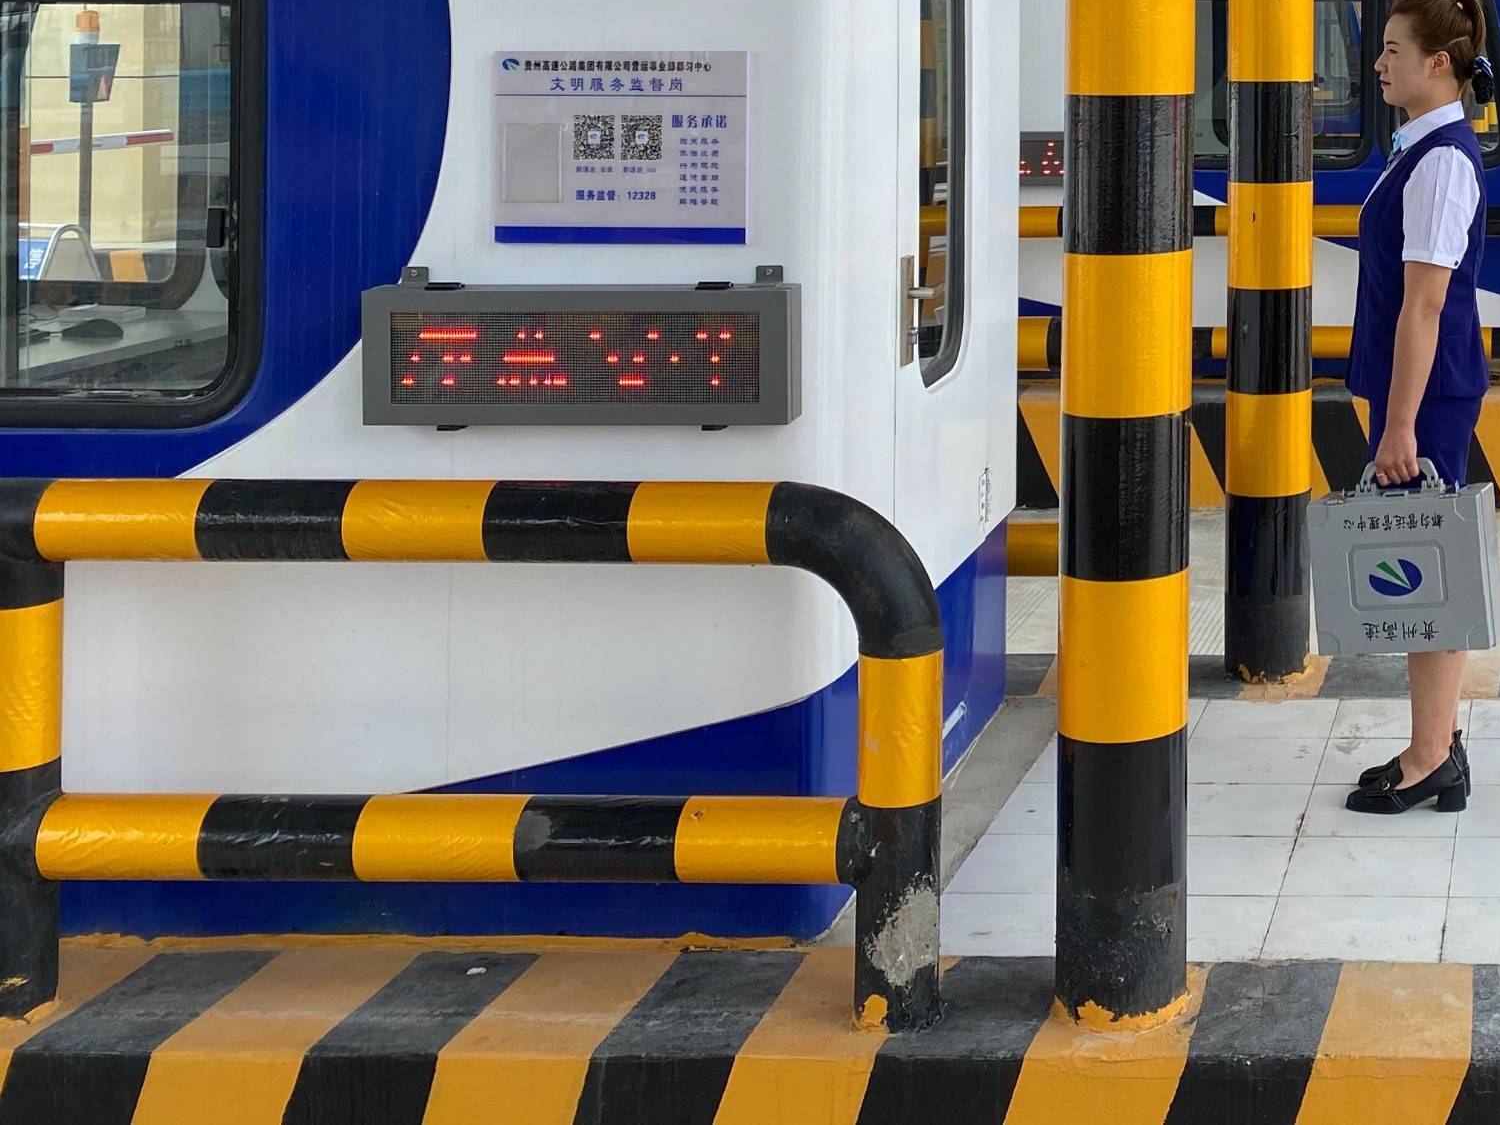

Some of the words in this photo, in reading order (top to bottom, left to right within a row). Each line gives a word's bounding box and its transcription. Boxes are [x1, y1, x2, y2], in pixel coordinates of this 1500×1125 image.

[550, 77, 684, 92] 文明服务监督岗
[671, 114, 727, 129] 服务承诺
[1343, 512, 1445, 533] 都匀营运管理中心
[1361, 620, 1439, 642] 贵州高速
